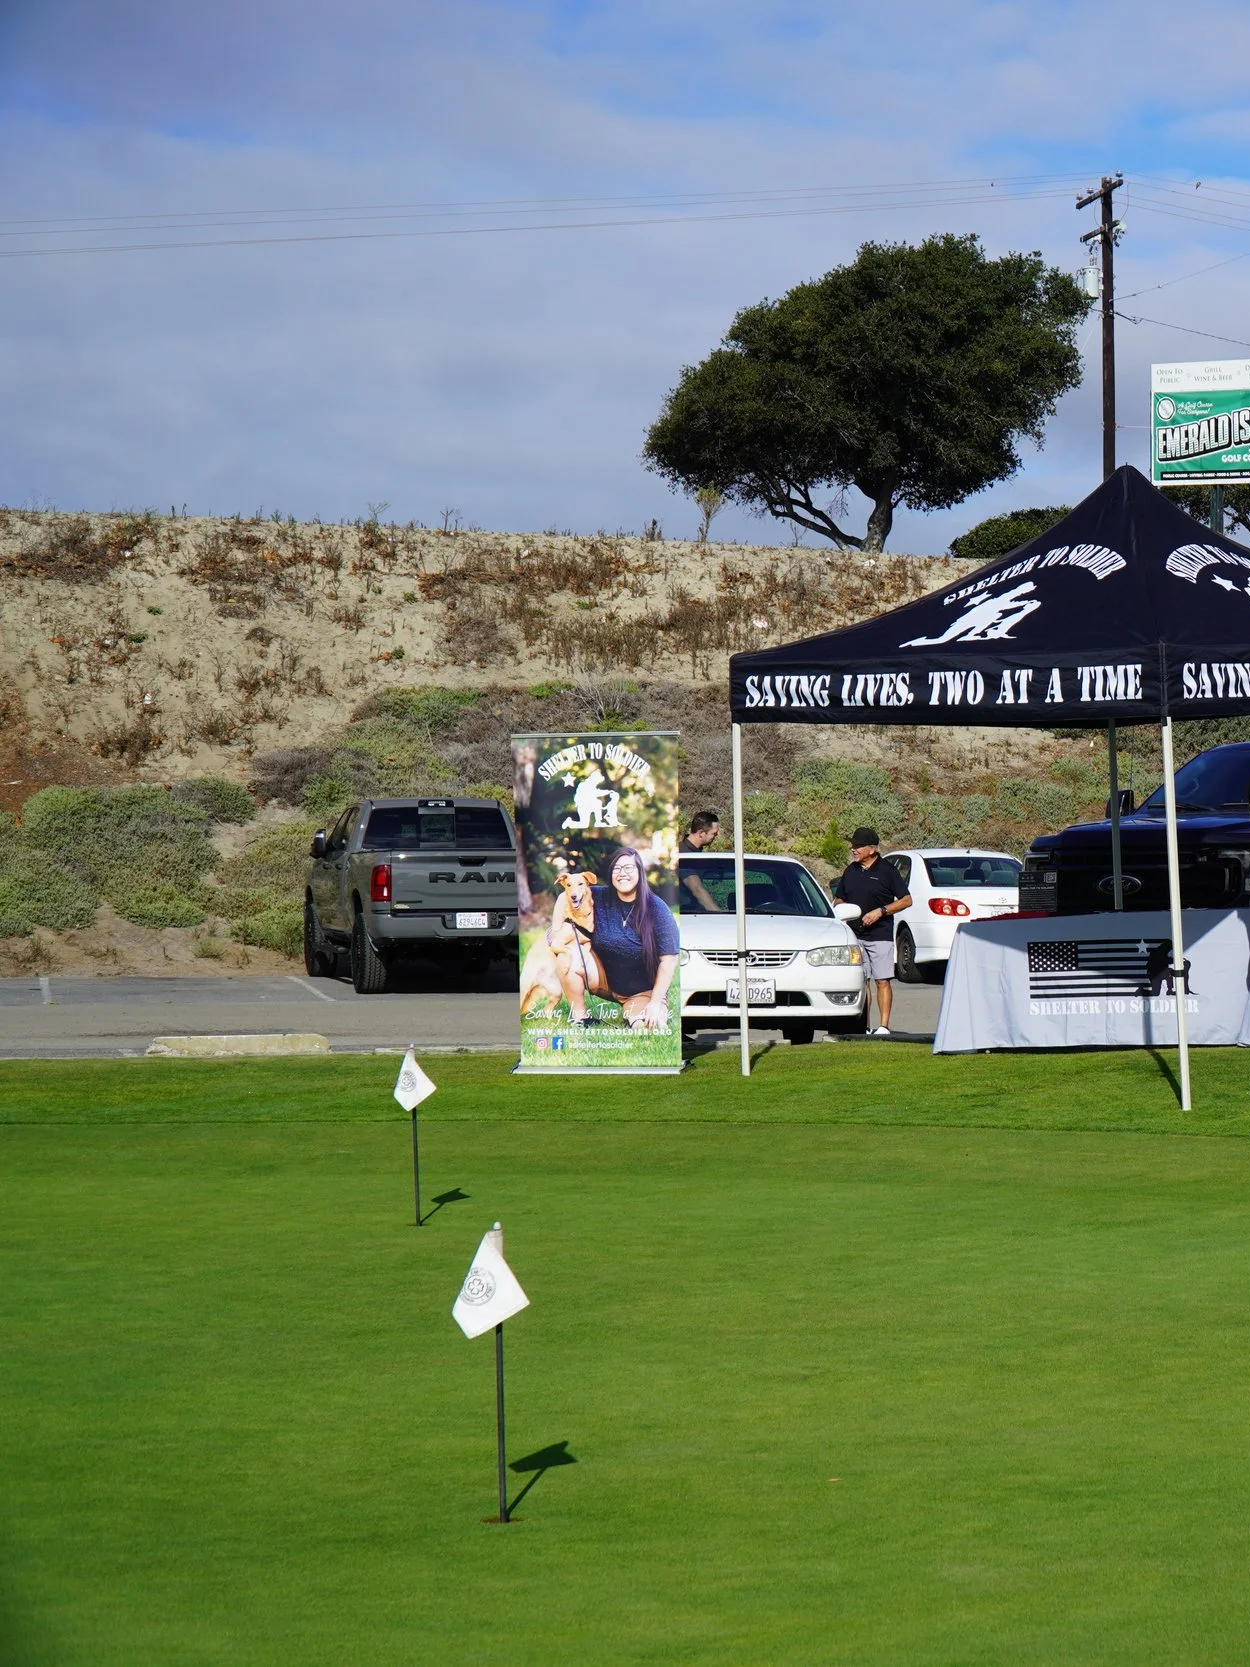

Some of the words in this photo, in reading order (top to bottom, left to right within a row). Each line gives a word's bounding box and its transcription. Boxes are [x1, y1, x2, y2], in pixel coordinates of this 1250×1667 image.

[1158, 414, 1231, 460] EMERALD
[1221, 454, 1241, 463] GOLF
[943, 555, 1041, 606] SHELTER
[1038, 546, 1069, 568] TO
[1060, 544, 1127, 580] SOLDIER
[745, 674, 830, 708] SAVING
[841, 672, 914, 707] LIVES,
[928, 670, 985, 705] TWO
[996, 669, 1032, 704] AT
[1045, 668, 1064, 703] A
[1077, 664, 1142, 702] TIME
[588, 742, 603, 760] TO
[428, 871, 515, 883] RAM
[730, 988, 772, 1000] 4ZD965
[596, 1003, 618, 1019] Two
[1029, 999, 1100, 1015] SHELTER
[1106, 999, 1125, 1014] TO
[1130, 999, 1199, 1014] SOLDIR
